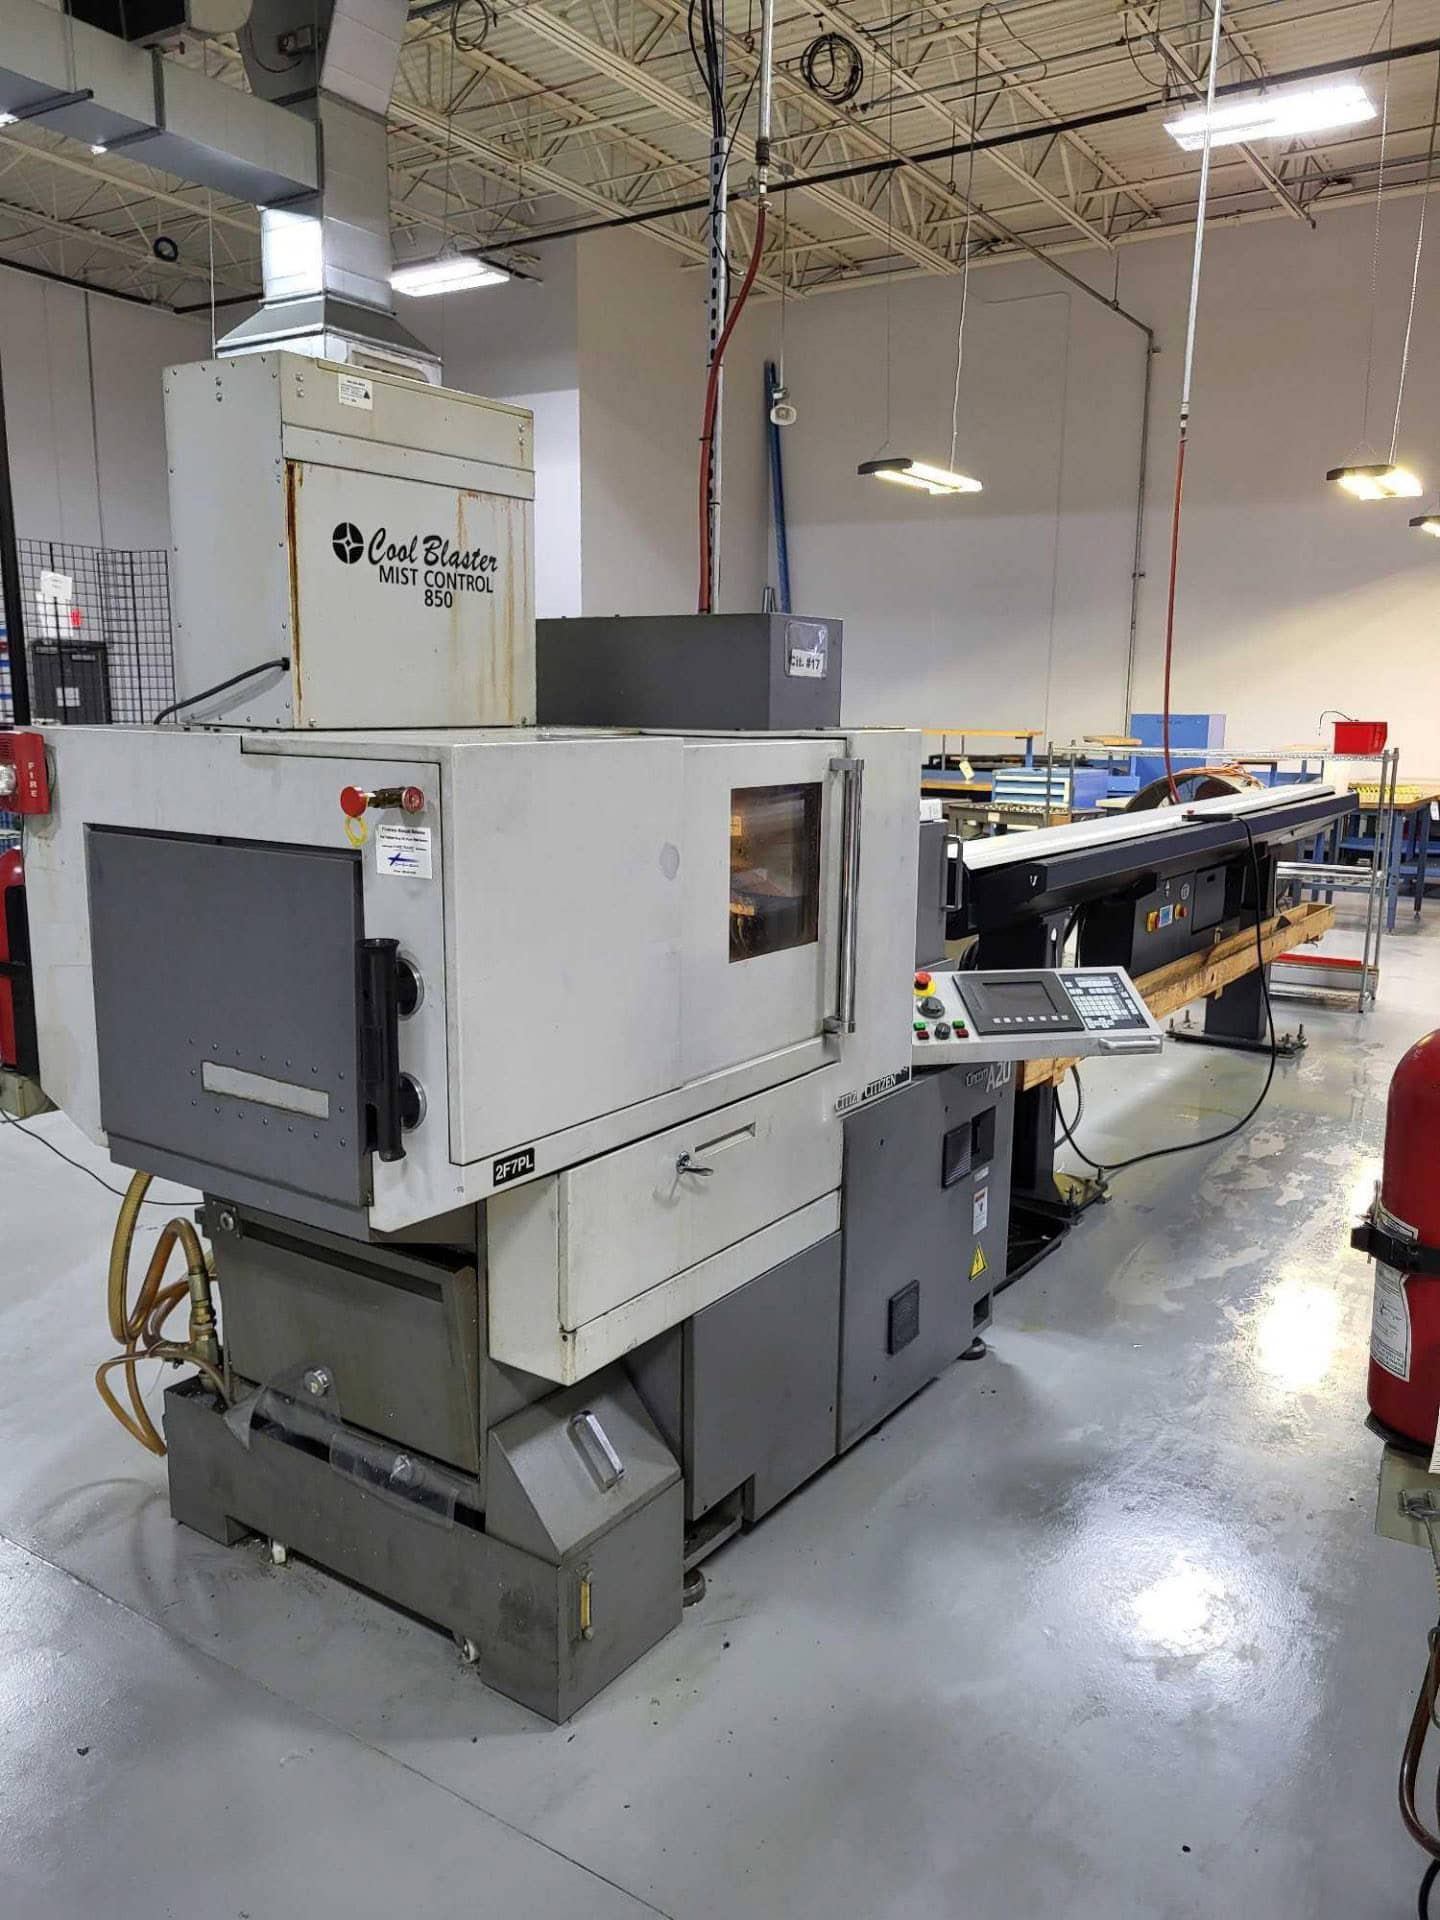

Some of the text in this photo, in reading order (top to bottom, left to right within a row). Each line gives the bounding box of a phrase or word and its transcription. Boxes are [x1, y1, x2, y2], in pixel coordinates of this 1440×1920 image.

[367, 527, 498, 573] Cool Blaster
[379, 565, 494, 593] MIST CONTROL
[424, 589, 453, 608] 850
[27, 761, 39, 798] FIRE
[864, 1073, 897, 1098] CITIZEN
[495, 1154, 534, 1181] 2F7PL
